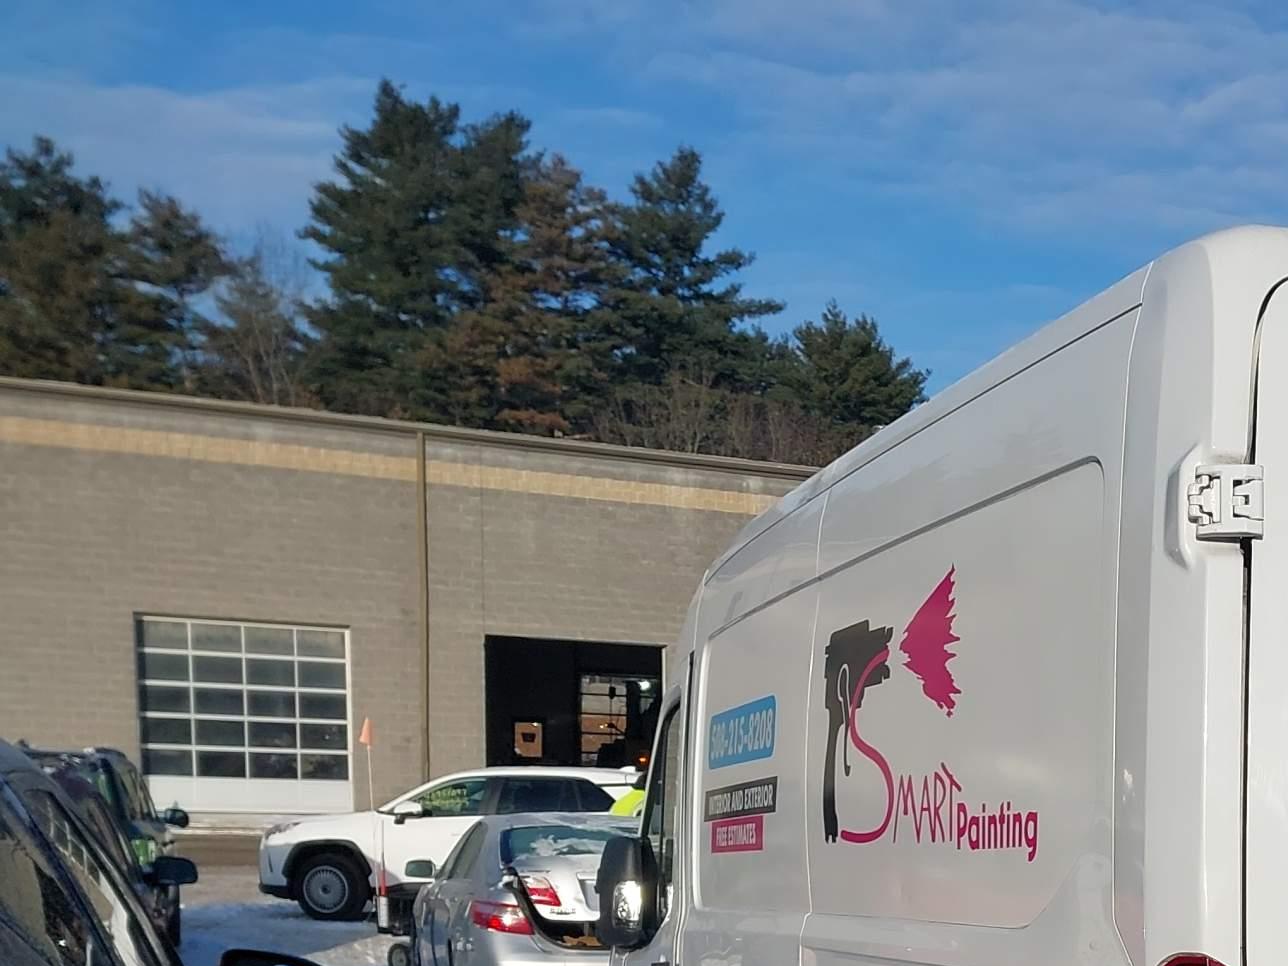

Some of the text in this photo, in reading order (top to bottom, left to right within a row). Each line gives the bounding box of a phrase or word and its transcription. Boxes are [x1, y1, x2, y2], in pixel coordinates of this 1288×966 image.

[731, 789, 744, 812] AND
[745, 783, 774, 809] EXTERIOR
[728, 823, 756, 845] ESTIMATES
[957, 802, 1038, 862] Painting
